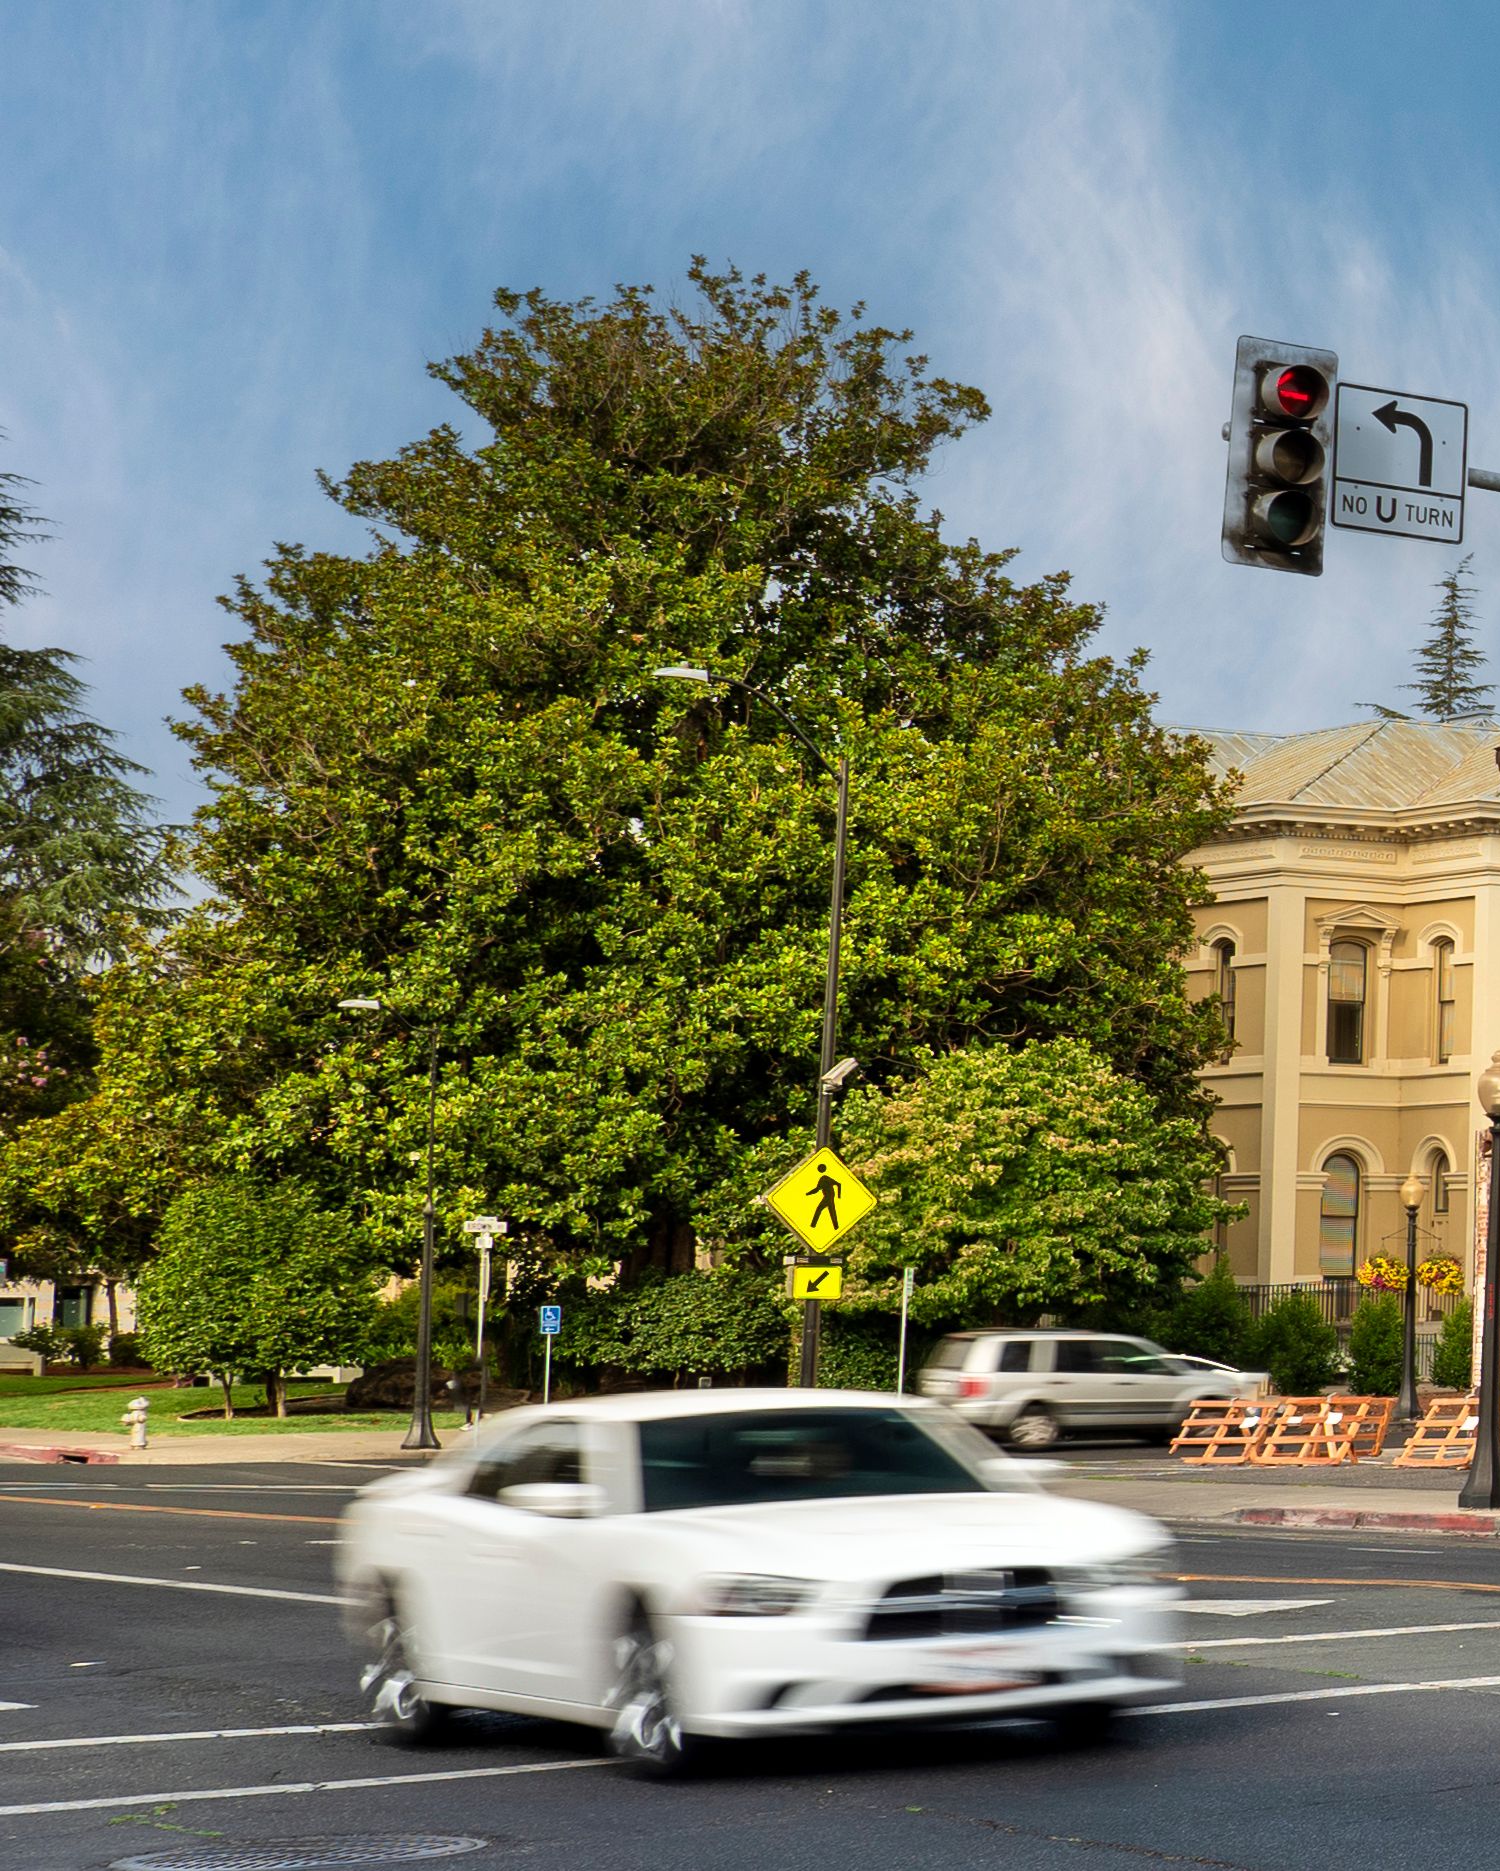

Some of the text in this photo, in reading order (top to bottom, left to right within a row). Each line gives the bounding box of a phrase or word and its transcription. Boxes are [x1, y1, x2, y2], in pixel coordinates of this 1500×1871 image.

[1341, 493, 1454, 528] NO U TURN
